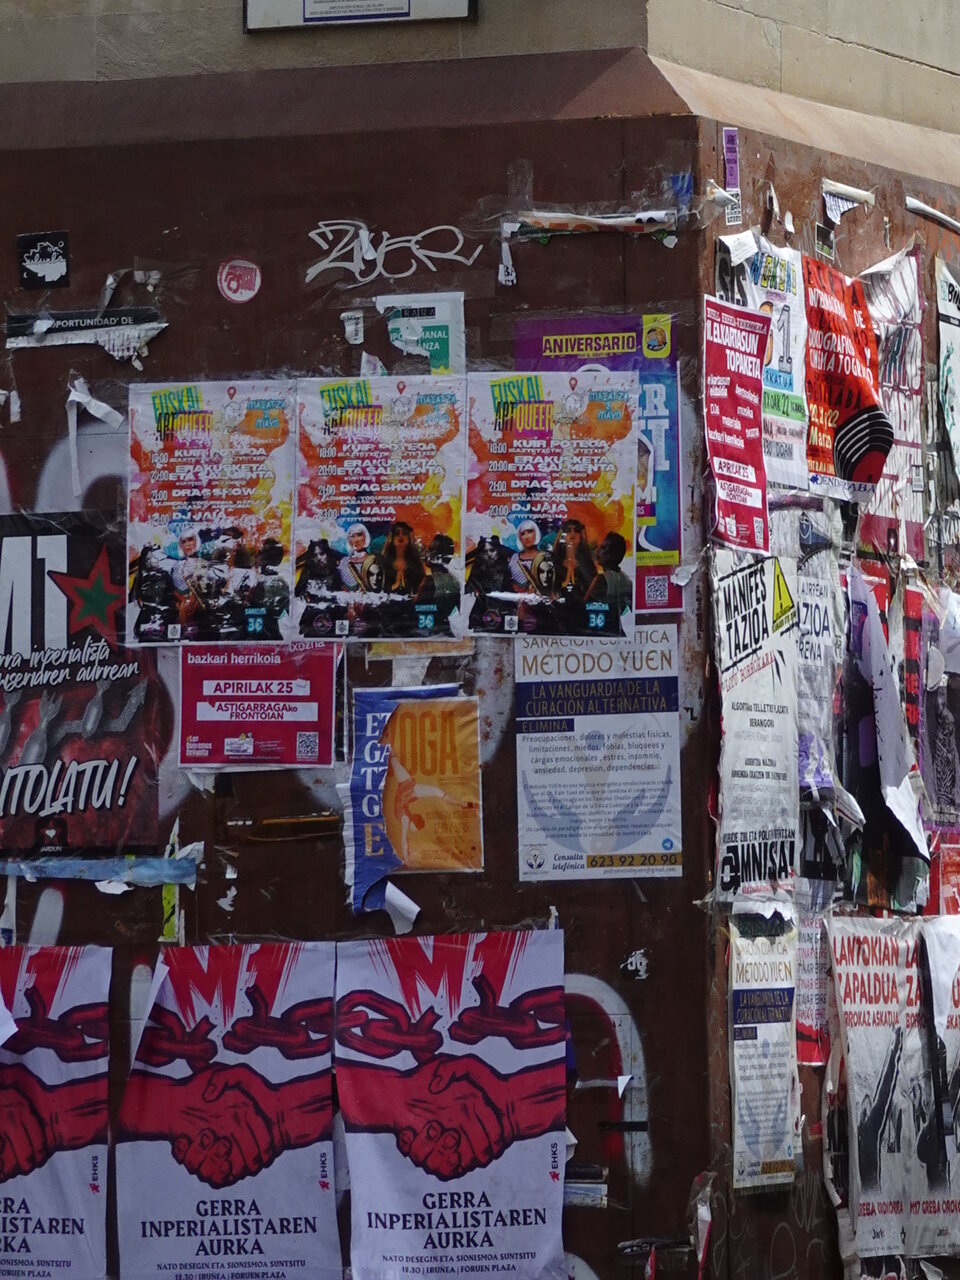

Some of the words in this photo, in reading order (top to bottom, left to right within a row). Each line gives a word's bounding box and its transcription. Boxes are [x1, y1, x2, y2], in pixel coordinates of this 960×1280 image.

[121, 316, 134, 326] DE
[543, 334, 635, 353] ANIVERSARIO
[725, 348, 761, 378] TOPAKETA
[490, 375, 542, 412] EUSKAL
[605, 401, 612, 410] 2
[494, 401, 517, 432] ART
[516, 403, 553, 432] QUEER
[597, 410, 622, 420] MAYO
[512, 439, 547, 448] KUIR
[488, 461, 509, 472] 20:00
[508, 464, 535, 472] ETA
[340, 483, 380, 491] DRAG
[381, 483, 426, 491] SHOW
[489, 480, 507, 491] 21:00
[510, 480, 552, 488] DRAG
[554, 480, 598, 488] SHOW
[340, 506, 360, 514] DJ
[361, 506, 396, 514] JAIA
[511, 503, 532, 512] DJ
[532, 503, 568, 513] JAIA
[723, 564, 768, 620] MANIFES
[726, 603, 770, 661] TAZIOA
[29, 636, 110, 671] inperialista
[187, 653, 228, 664] bazkari
[231, 653, 281, 664] herrikoia
[522, 649, 613, 676] MÉTODO
[619, 649, 673, 672] YUEN
[76, 660, 140, 685] aurrean
[213, 682, 275, 694] APIRILAK
[276, 682, 293, 694] 25
[532, 684, 546, 699] LA
[549, 681, 625, 698] VANGUARDIA
[627, 680, 642, 695] DE
[645, 680, 660, 694] LA
[216, 703, 298, 713] ASTIGARRAGAko
[525, 697, 585, 716] CURACIÓN
[587, 696, 667, 713] ALTERNATIVA
[229, 711, 284, 720] FRONTOIAN
[521, 721, 569, 732] ELIMINA
[522, 734, 578, 743] Preocupaciones,
[579, 732, 605, 741] dolores
[612, 731, 646, 739] molestias
[529, 744, 573, 754] limitaciones,
[602, 742, 627, 751] fobias,
[627, 741, 659, 751] bloqueos
[530, 756, 554, 765] cargas
[555, 754, 598, 763] emocionales
[603, 752, 627, 762] estrés,
[627, 752, 662, 760] insomnio,
[533, 765, 567, 774] ansiedad,
[553, 852, 584, 862] Consulta
[590, 856, 614, 868] 623
[618, 855, 635, 867] 92
[640, 855, 656, 866] 20
[660, 854, 678, 865] 90
[552, 861, 585, 872] telefónica
[833, 934, 899, 967] LANTOKIAN
[91, 1155, 99, 1181] EHKS
[422, 1191, 492, 1209] GERRA
[196, 1199, 262, 1218] GERRA
[367, 1208, 547, 1230] INPERIALISTAREN
[140, 1217, 318, 1238] INPERIALISTAREN
[423, 1231, 494, 1249] AURKA
[195, 1238, 264, 1256] AURKA
[382, 1255, 404, 1263] NATO
[405, 1254, 439, 1263] DESEGIN
[439, 1254, 455, 1262] ETA
[456, 1253, 498, 1262] SIONISMOA
[500, 1251, 536, 1260] SUNTSITU
[36, 1259, 72, 1268] SUNTSITU
[157, 1263, 176, 1271] NATO
[177, 1262, 209, 1270] DESEGIN
[211, 1261, 225, 1269] ETA
[227, 1261, 268, 1269] SIONISMOA
[270, 1260, 306, 1268] SUNTSITU
[460, 1265, 490, 1273] FORUEN
[491, 1264, 517, 1272] PLAZA
[27, 1270, 51, 1278] PLAZA
[265, 1271, 286, 1279] PLAZA
